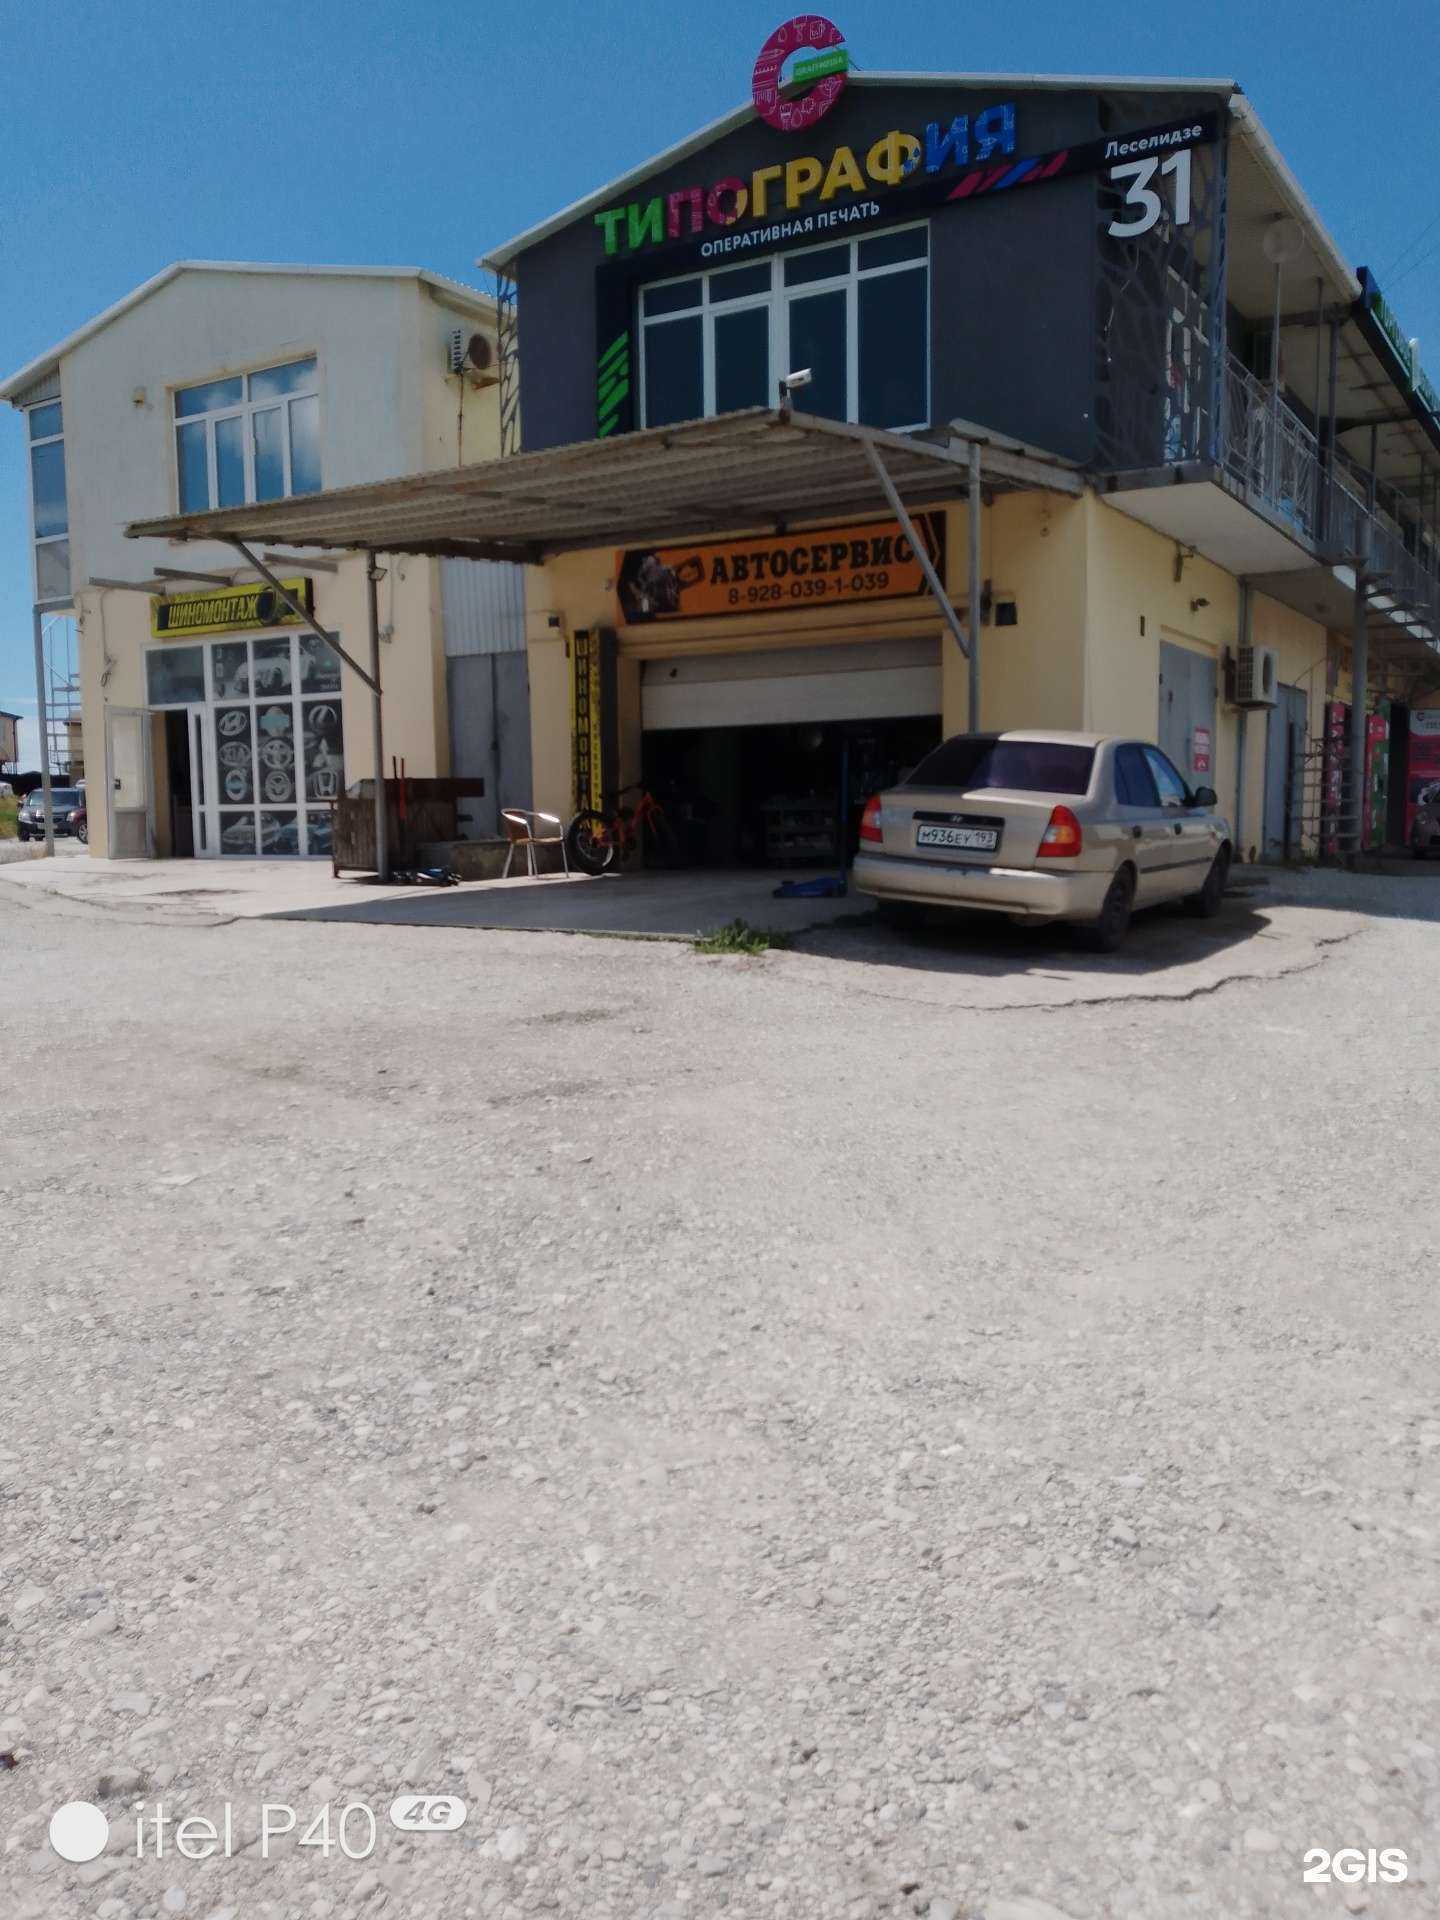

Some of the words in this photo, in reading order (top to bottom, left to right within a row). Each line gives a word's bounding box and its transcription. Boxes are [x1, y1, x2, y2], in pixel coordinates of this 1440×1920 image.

[1105, 124, 1202, 158] Леселидзе
[594, 103, 1016, 256] ТИПОГРАФИЯ
[1108, 149, 1192, 238] 31
[701, 216, 813, 257] ОПЕРАТИВНАЯ
[817, 201, 880, 229] ПЕЧАТЬ
[711, 534, 915, 584] АВТОСЕРВИС
[169, 594, 257, 627] ШИНОМОНТАЖ
[728, 572, 889, 606] 8-928-039-1-039
